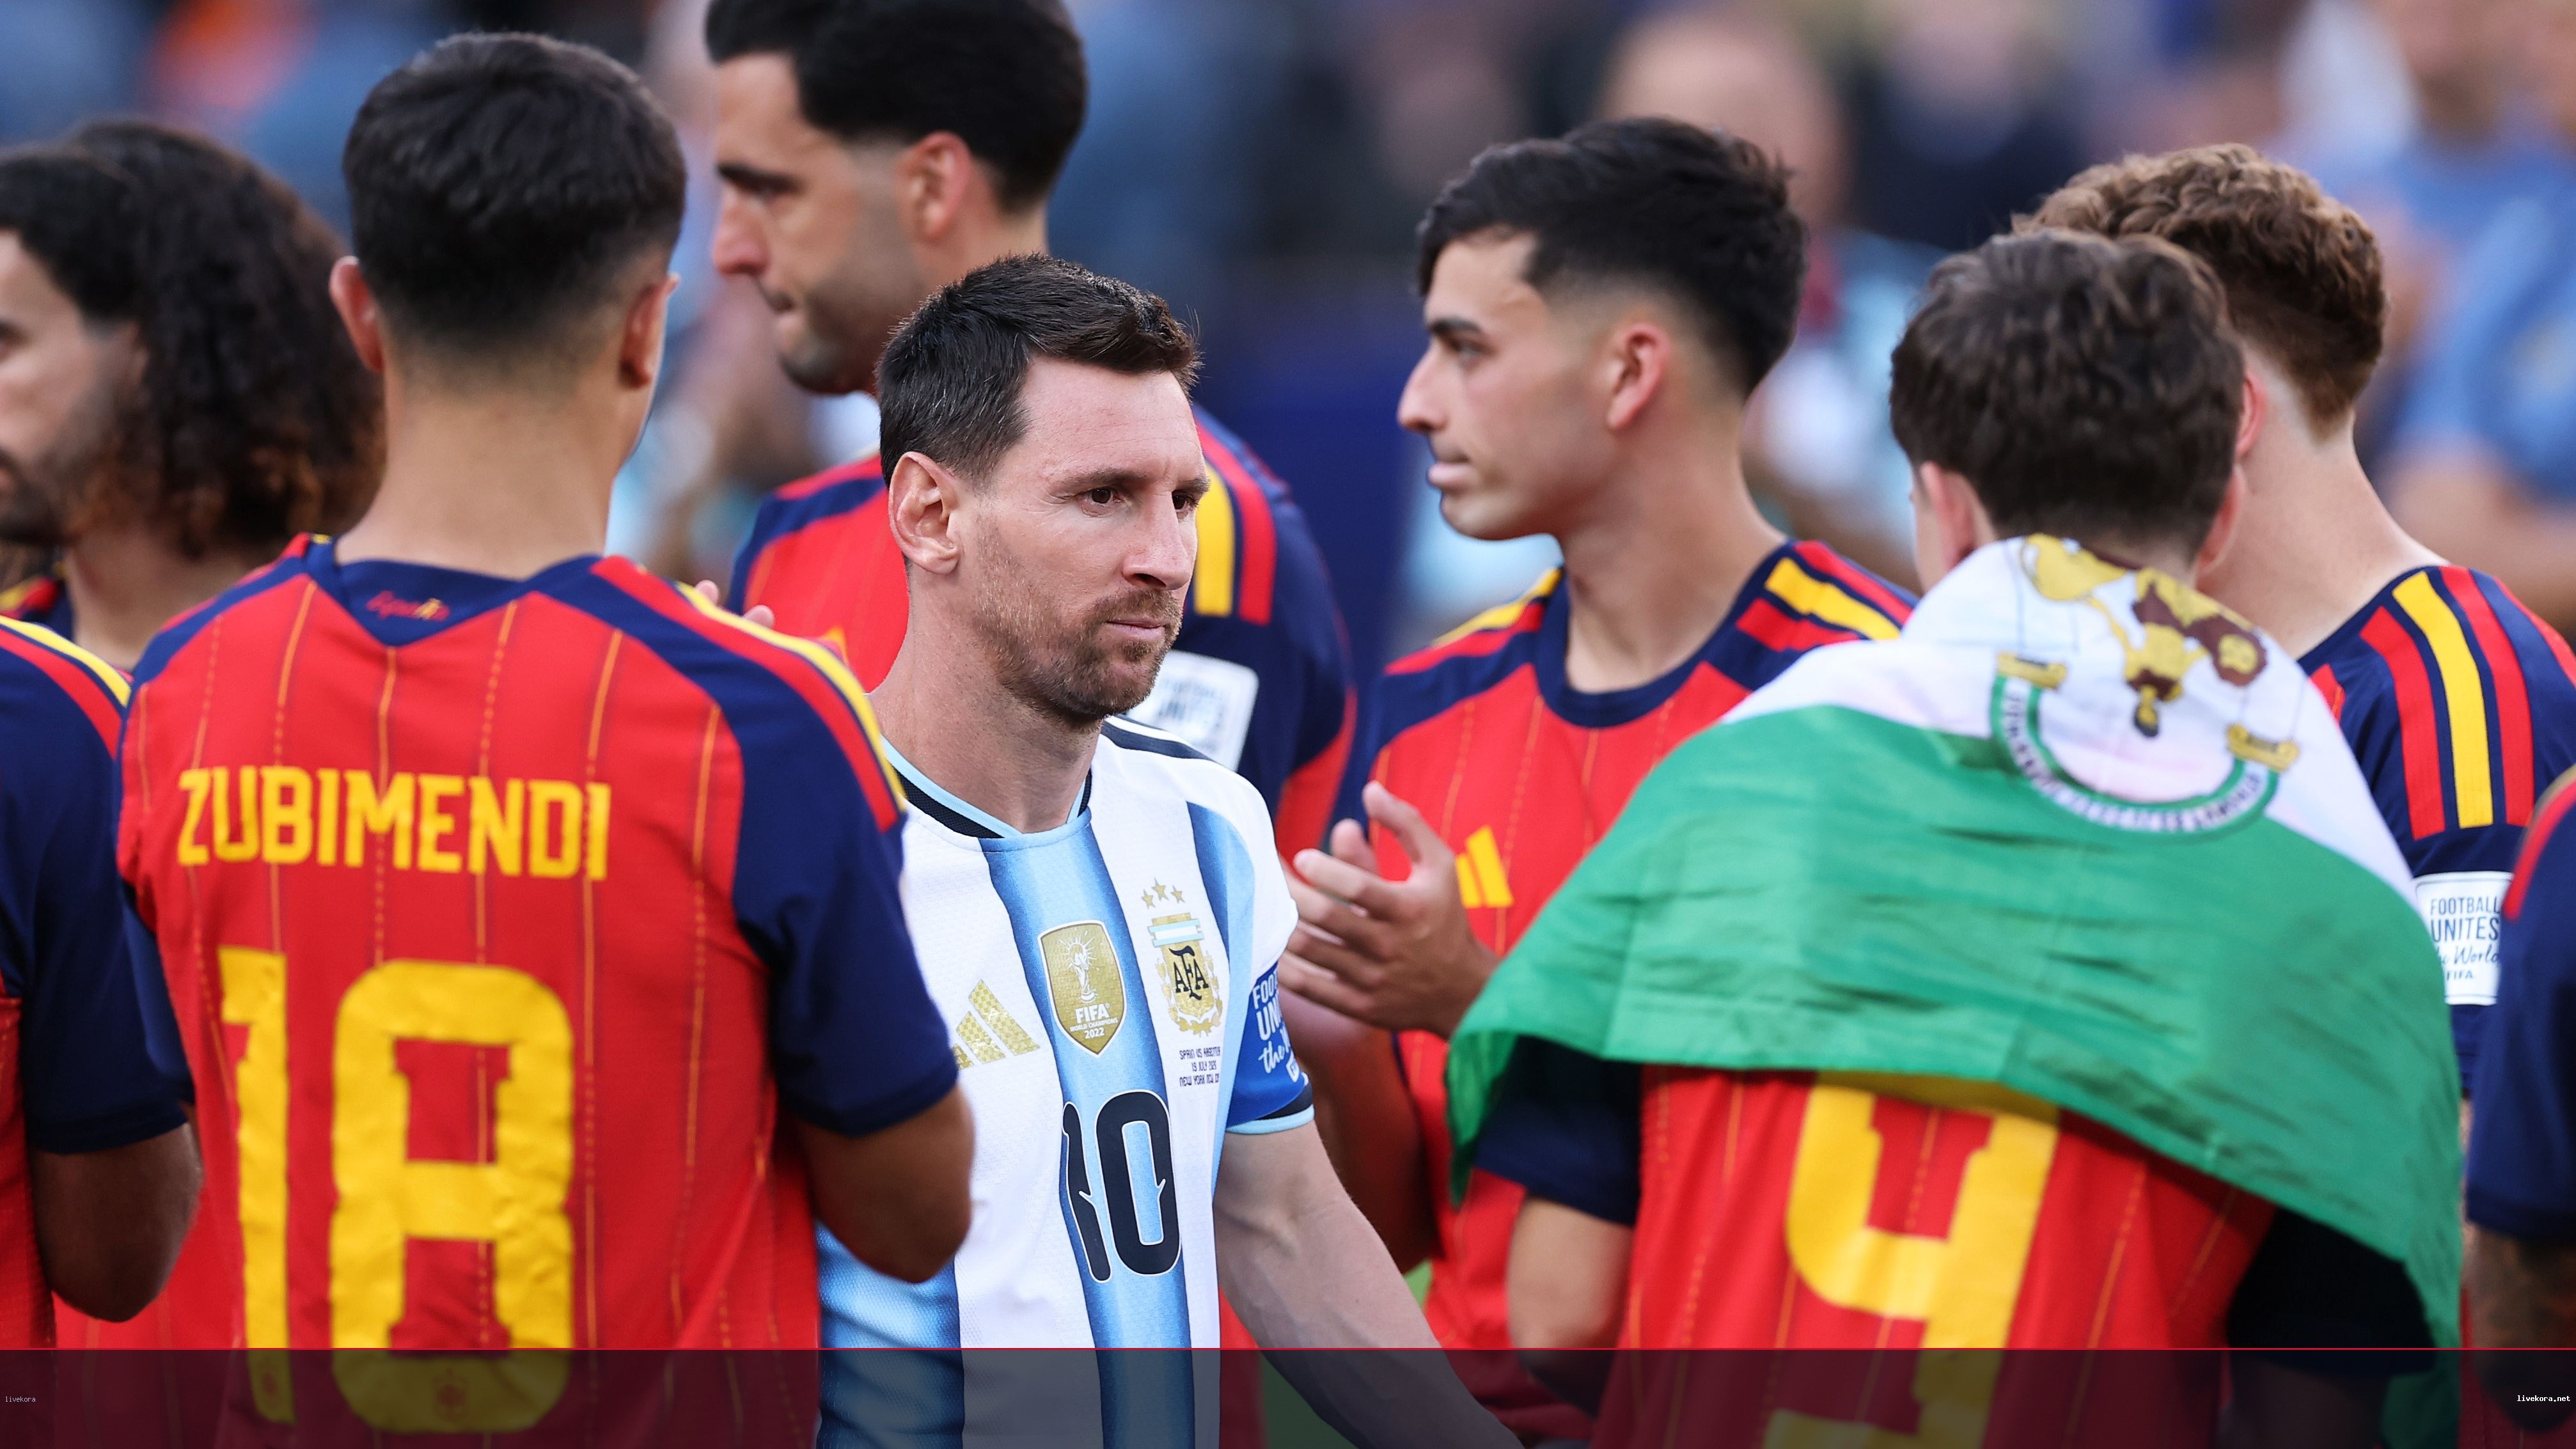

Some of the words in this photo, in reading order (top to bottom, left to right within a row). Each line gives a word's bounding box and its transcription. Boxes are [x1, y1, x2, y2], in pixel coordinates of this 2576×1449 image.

[178, 766, 611, 881] ZUBIMENDI
[2431, 897, 2501, 914] FOOTBALL
[2431, 916, 2500, 943] UNITES
[1168, 945, 1209, 1001] AFA
[2446, 970, 2473, 980] FIFA
[1069, 1024, 1088, 1032] WORLD
[1088, 1017, 1119, 1028] CHAMPIONS
[1075, 1003, 1110, 1024] FIFA
[1084, 1027, 1105, 1039] 2022
[1258, 1040, 1285, 1074] the
[218, 945, 574, 1433] 18
[1062, 1090, 1181, 1283] 10
